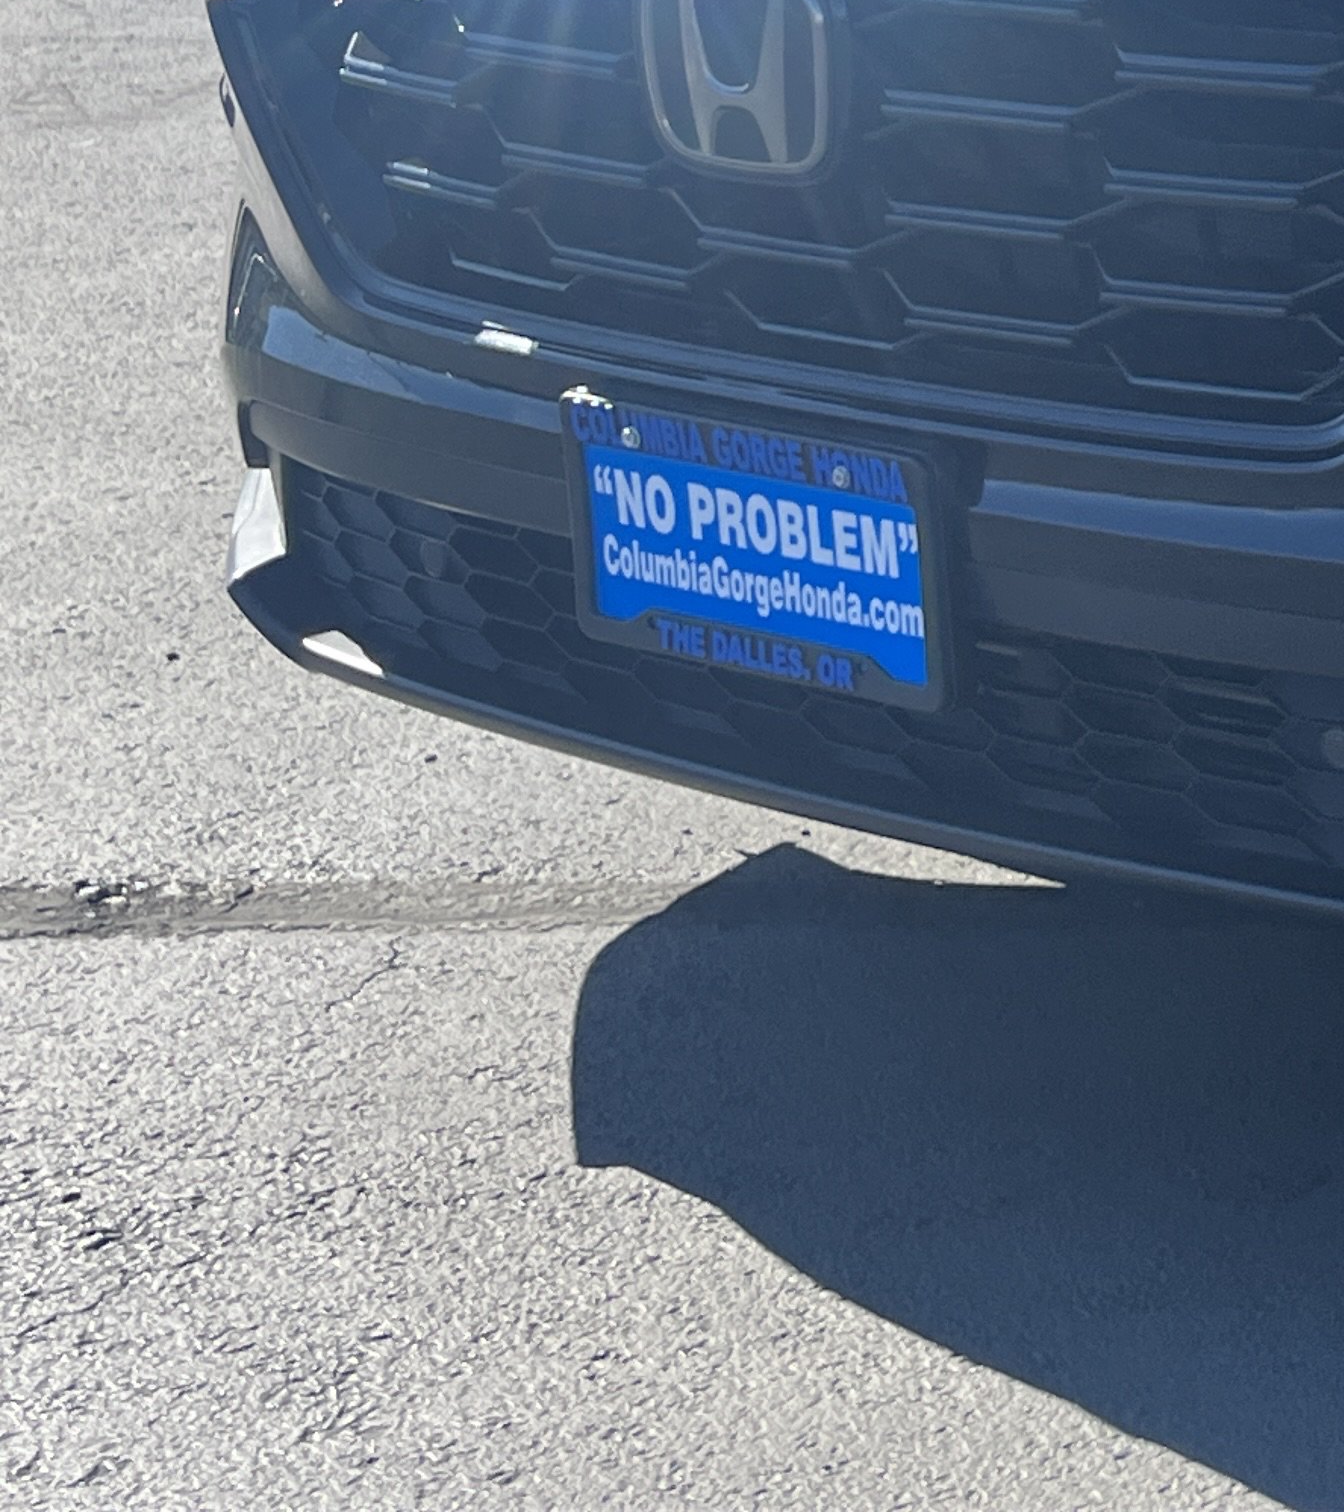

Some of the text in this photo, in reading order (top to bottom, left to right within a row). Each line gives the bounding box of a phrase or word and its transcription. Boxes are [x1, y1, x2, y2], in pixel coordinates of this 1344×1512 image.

[711, 424, 807, 482] GORGE
[602, 533, 925, 638] ColumbiaGorgeHonda.com
[654, 618, 706, 659] THE
[816, 654, 855, 691] OR
